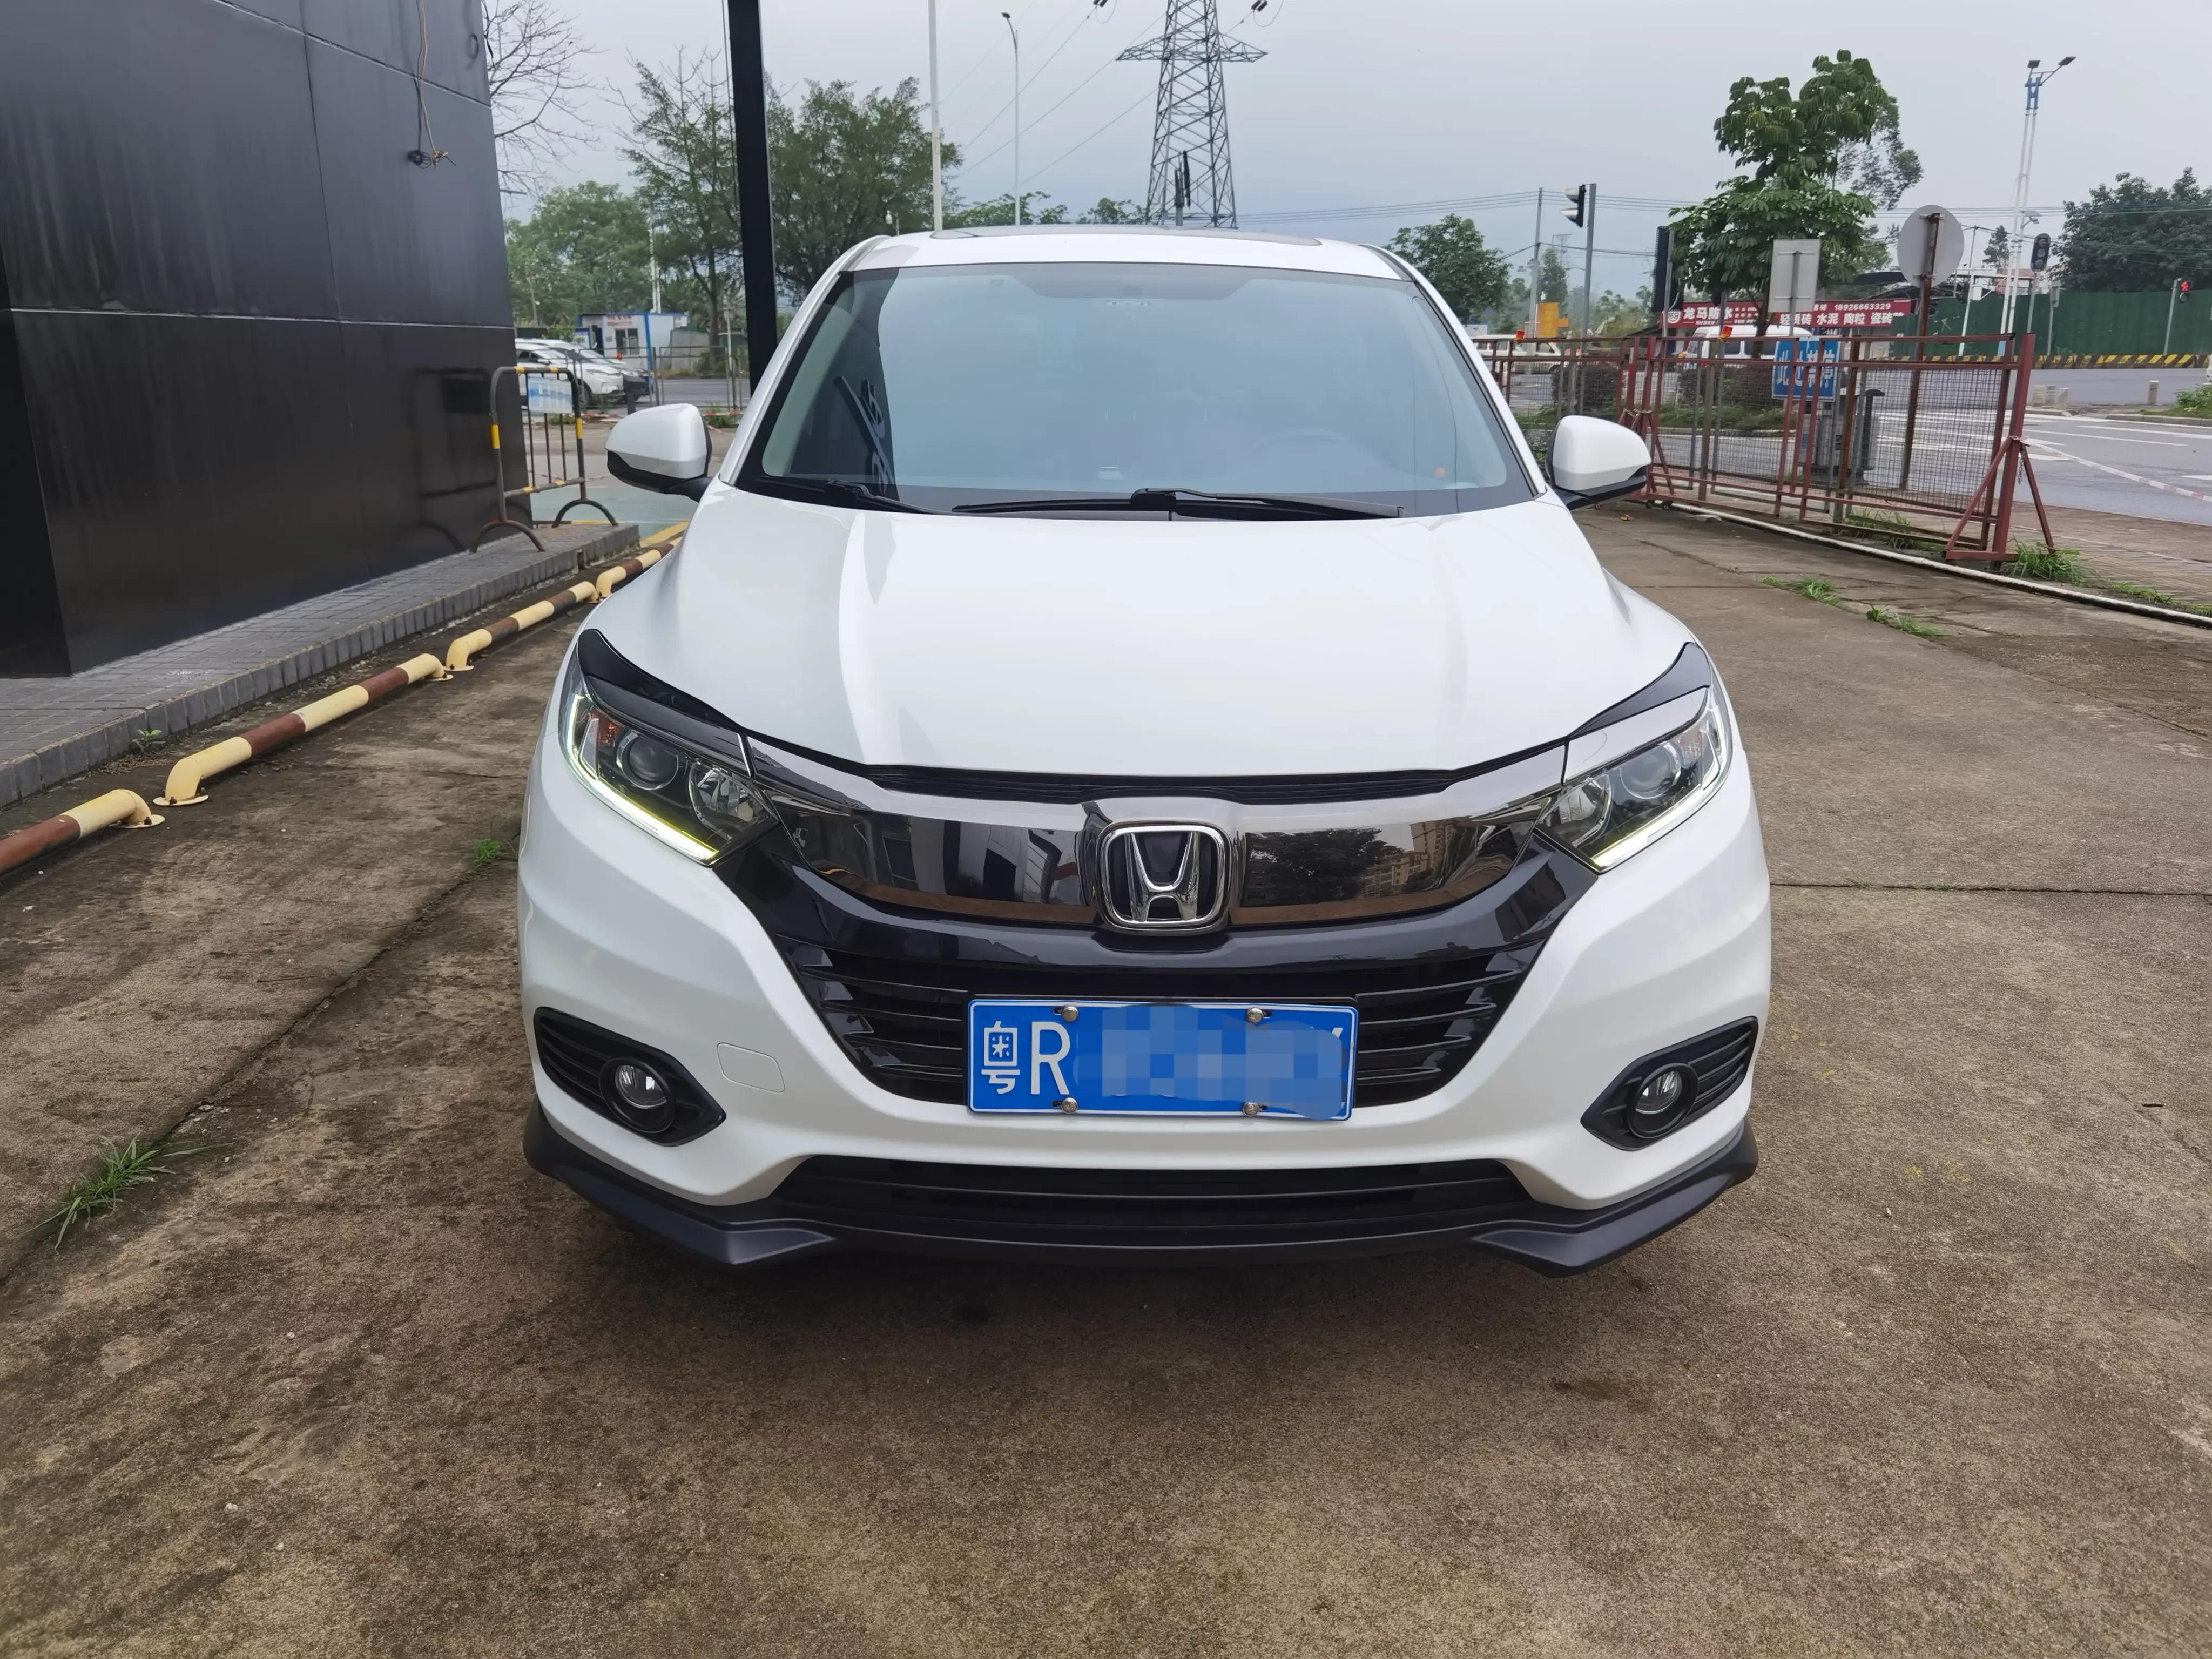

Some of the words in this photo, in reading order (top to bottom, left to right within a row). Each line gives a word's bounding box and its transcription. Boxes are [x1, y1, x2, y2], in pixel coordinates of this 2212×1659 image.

[1835, 302, 1891, 311] 18926663329
[1683, 307, 1733, 320] 龙马防水
[1817, 313, 1838, 325] 水泥
[1844, 313, 1866, 325] 陶粒
